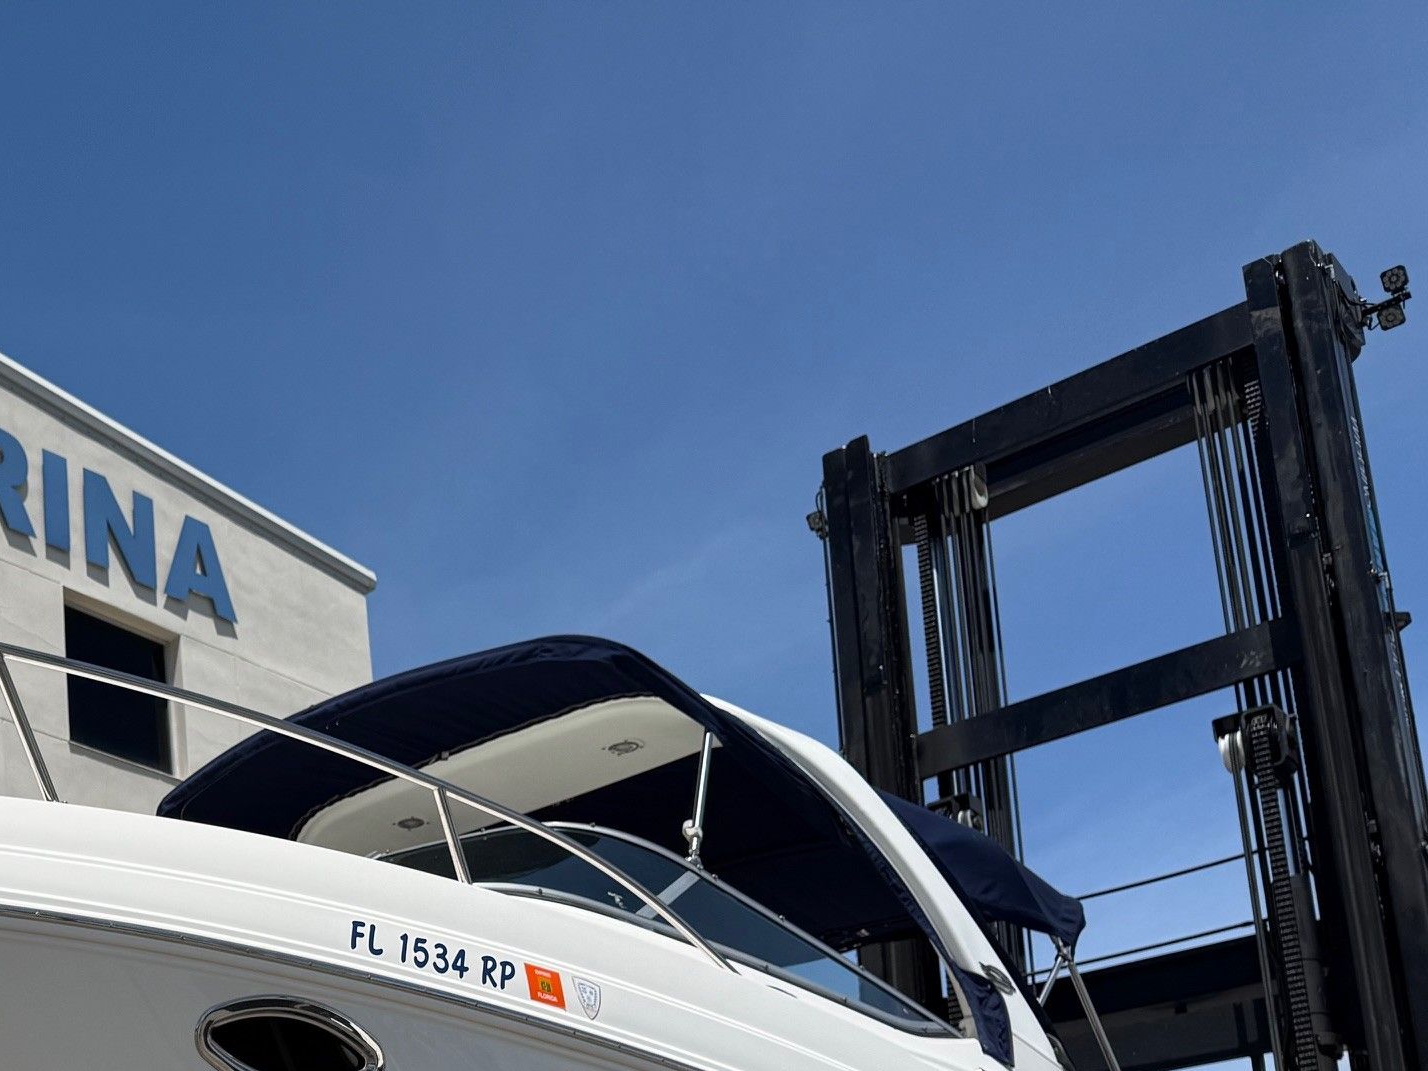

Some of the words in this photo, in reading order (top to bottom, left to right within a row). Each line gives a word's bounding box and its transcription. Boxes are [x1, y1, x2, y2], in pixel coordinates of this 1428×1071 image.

[350, 920, 384, 956] FL
[400, 933, 470, 979] 1534
[481, 955, 516, 990] RP
